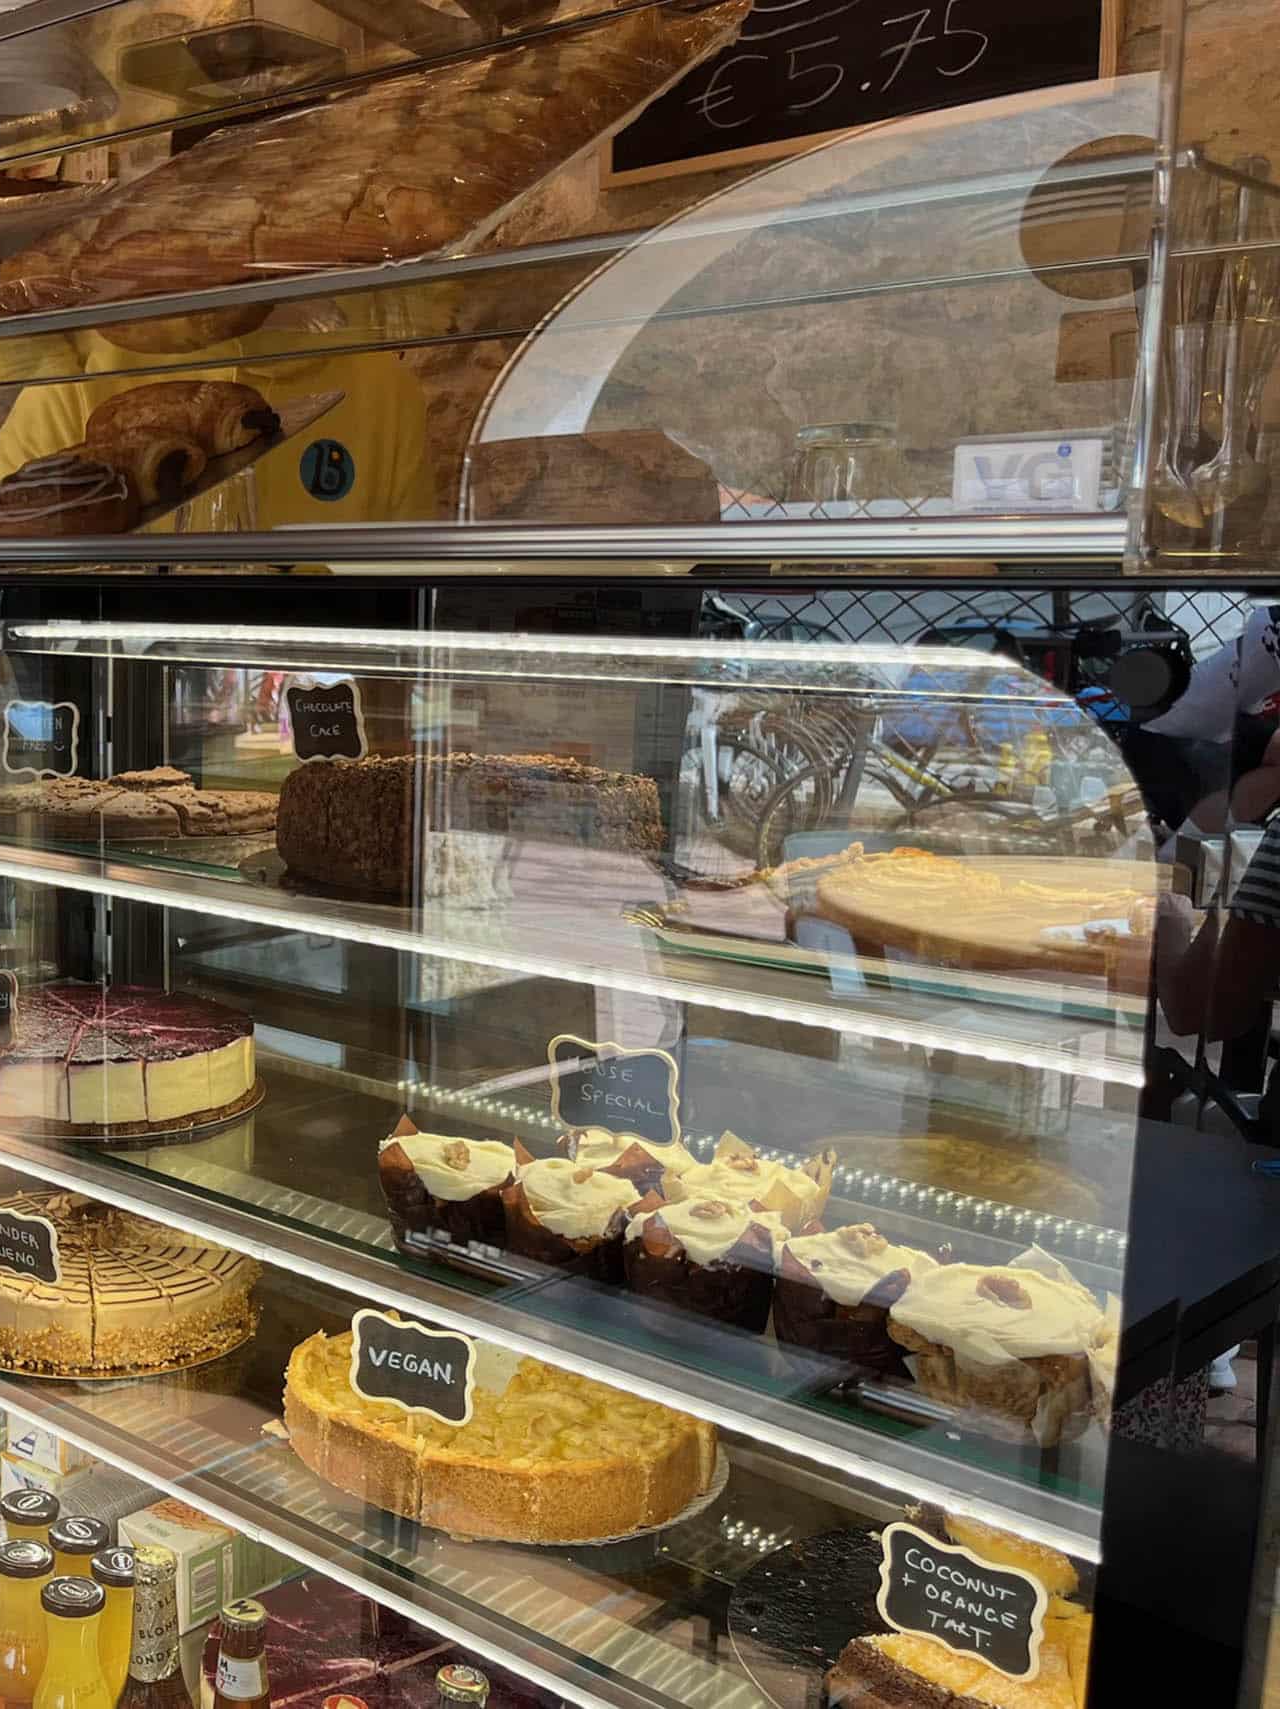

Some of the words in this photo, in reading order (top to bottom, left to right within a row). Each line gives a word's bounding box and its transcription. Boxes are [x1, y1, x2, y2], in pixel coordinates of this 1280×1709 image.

[310, 724, 341, 737] CAKE
[581, 1083, 665, 1116] SPECIAL
[905, 1548, 1017, 1601] COCONUT
[925, 1584, 1018, 1630] ORANGE
